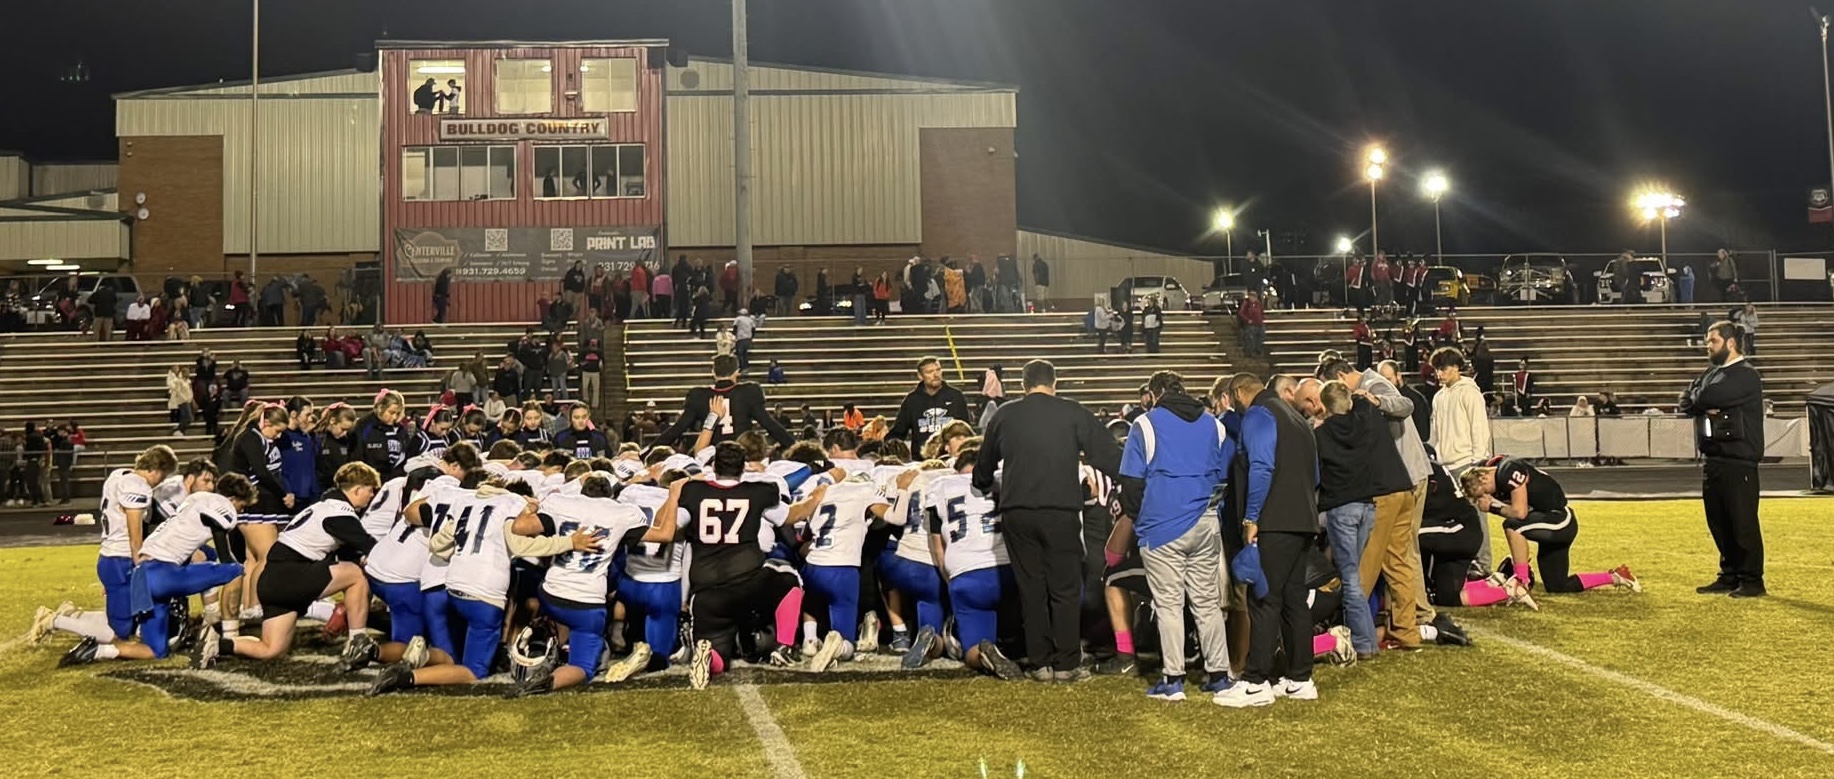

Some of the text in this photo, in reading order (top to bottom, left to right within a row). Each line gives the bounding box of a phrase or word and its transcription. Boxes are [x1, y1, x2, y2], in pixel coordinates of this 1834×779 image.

[446, 122, 600, 135] BULLDOG COUNTRY
[404, 243, 454, 259] CENTERVILLE
[586, 235, 656, 251] PRINT LAB
[1508, 470, 1526, 488] 12
[453, 505, 497, 556] 41
[699, 499, 750, 545] 67
[815, 504, 838, 548] 2
